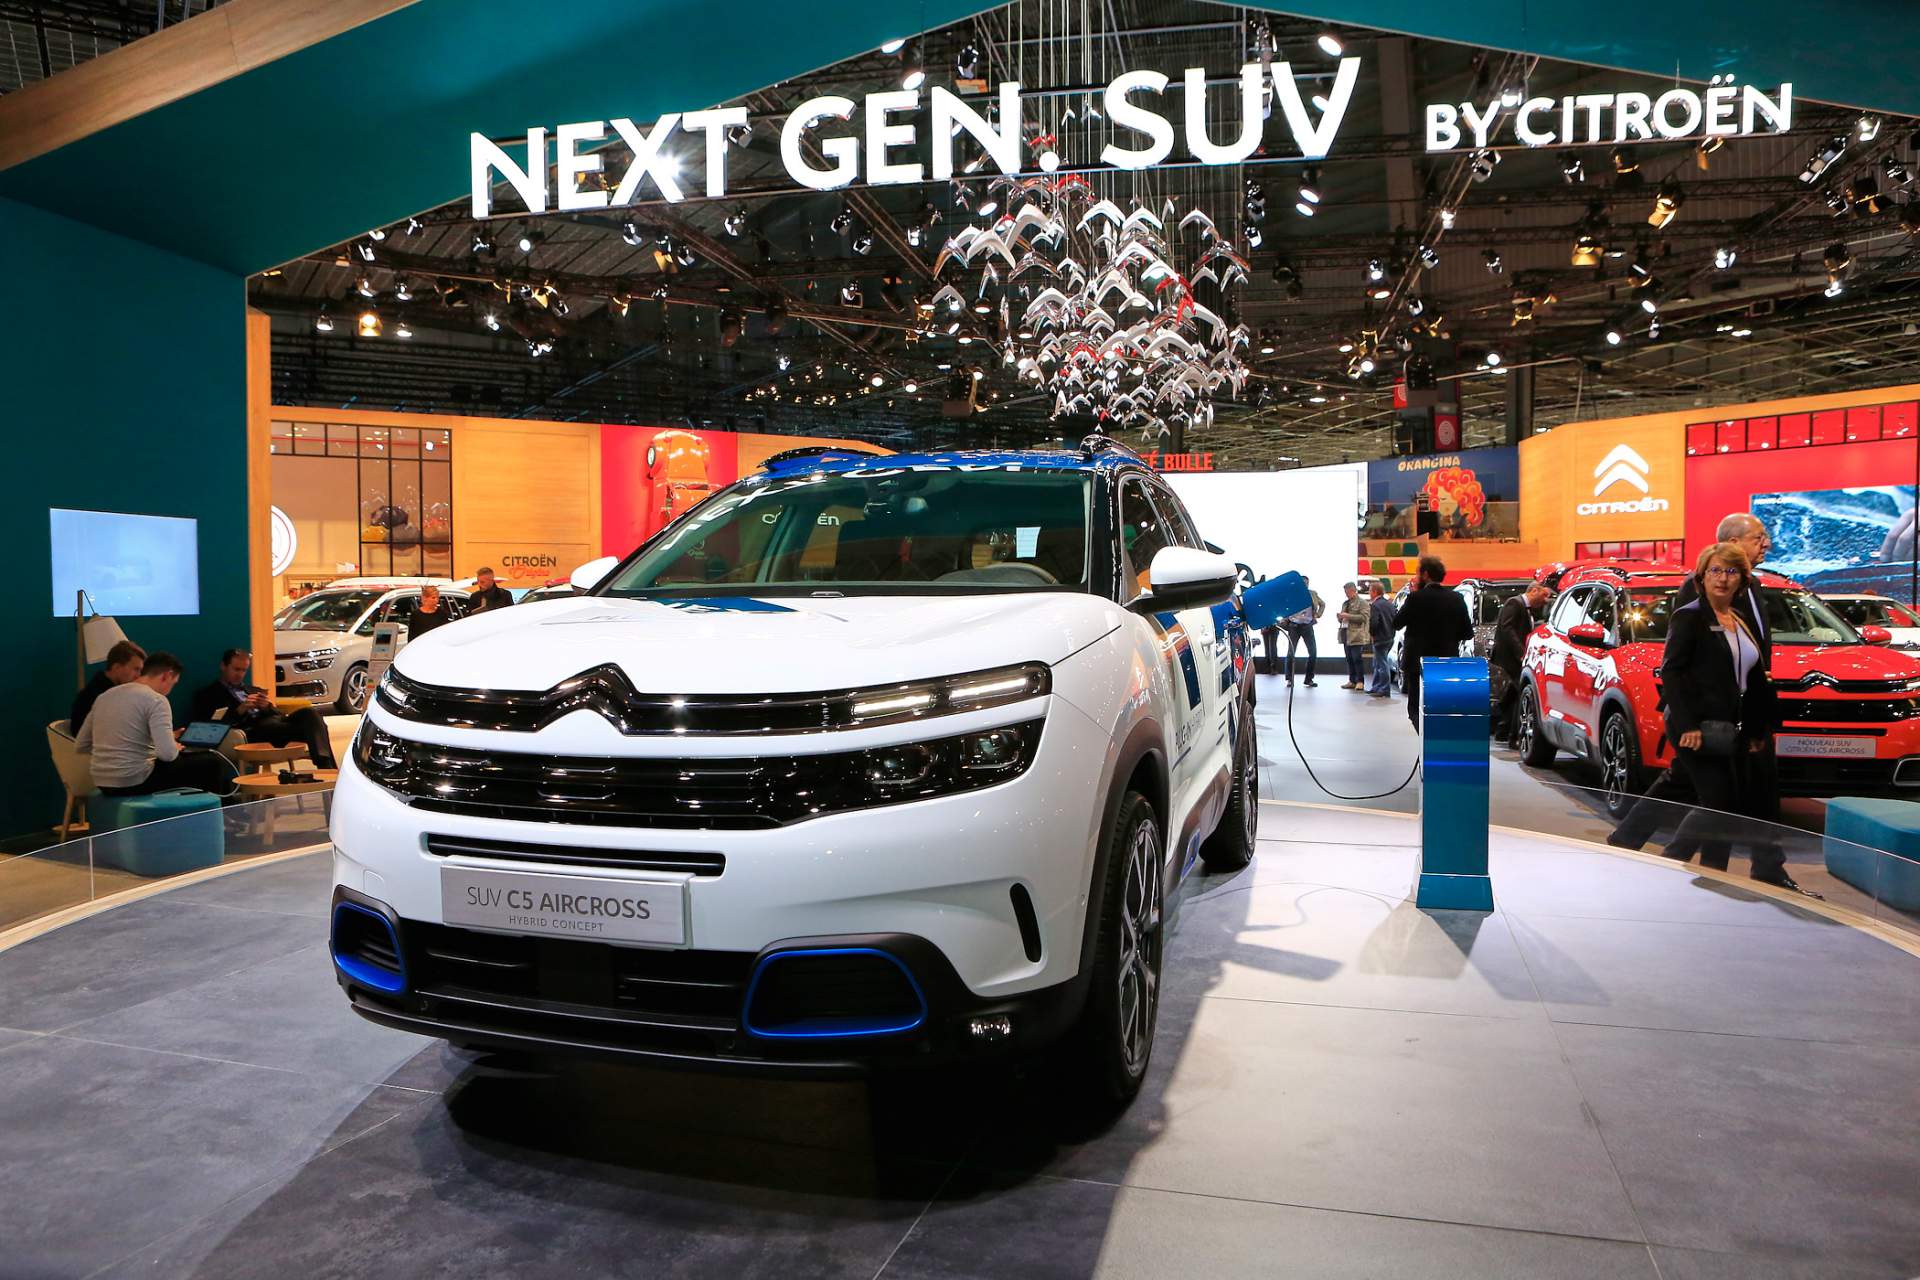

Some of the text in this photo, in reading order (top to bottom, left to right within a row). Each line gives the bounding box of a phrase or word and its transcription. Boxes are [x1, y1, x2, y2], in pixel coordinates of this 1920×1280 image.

[1426, 73, 1793, 152] BY CITROËN
[470, 56, 1361, 220] NEXT GEN. SUV
[1164, 452, 1214, 471] BULLE
[1397, 455, 1461, 471] ORANGINA
[502, 553, 557, 567] CITROËN
[467, 886, 651, 920] SUV C5 AIRCROSS
[509, 914, 604, 933] HYBRID CONCEPT
